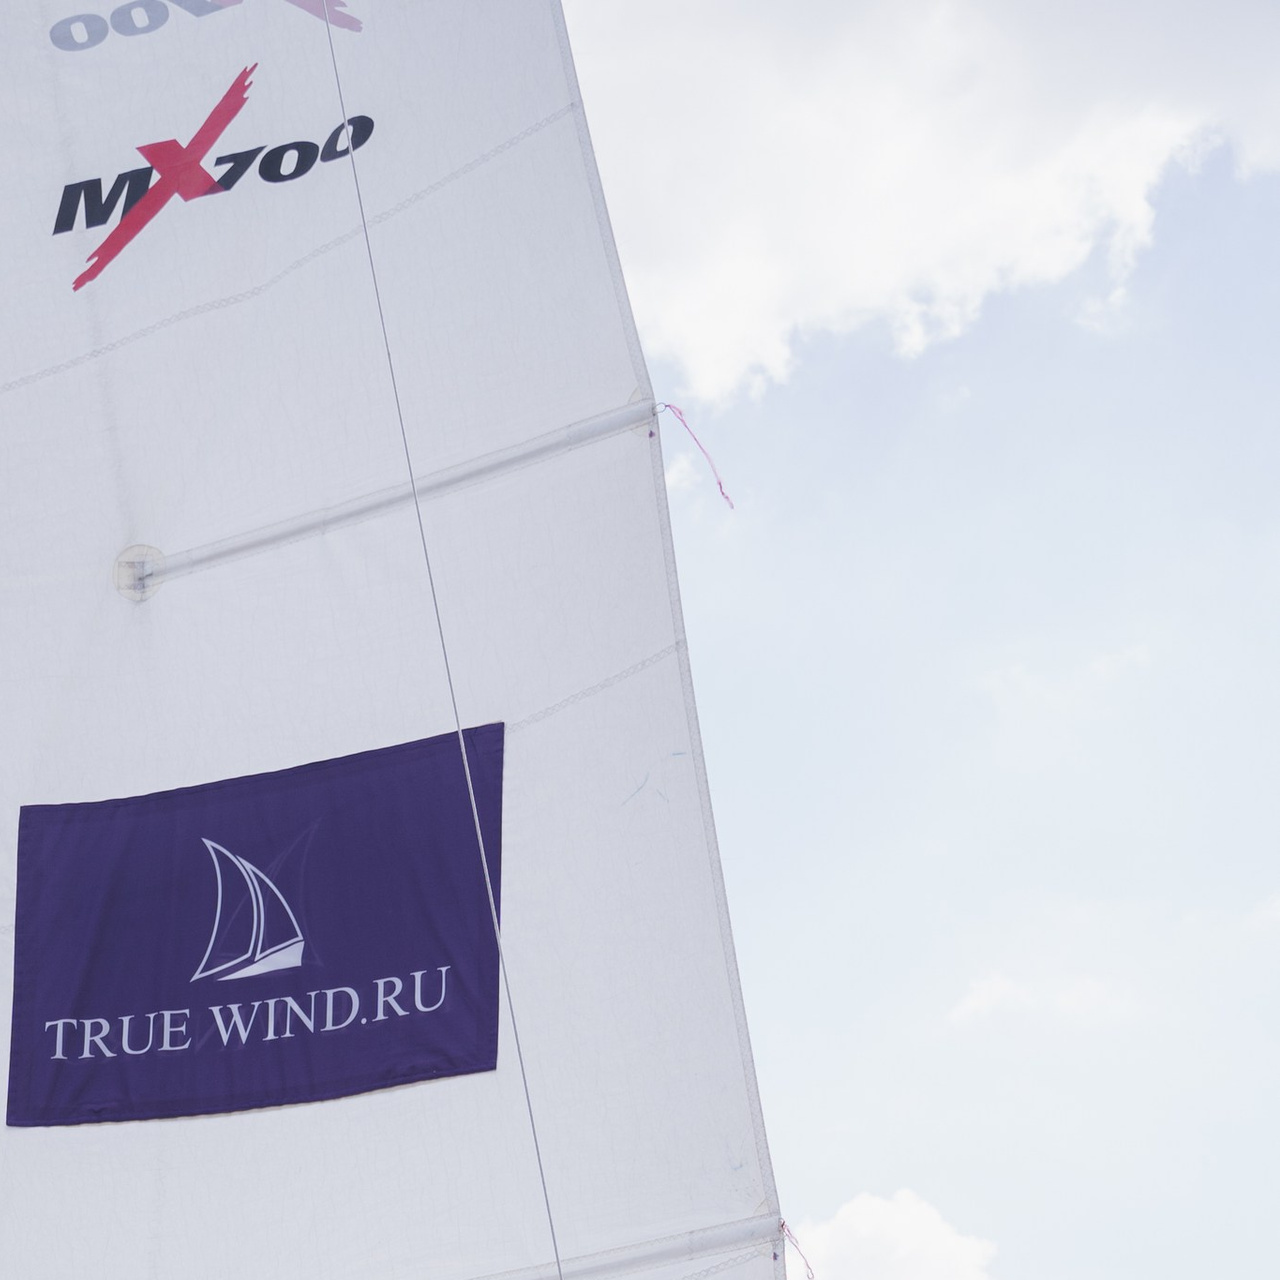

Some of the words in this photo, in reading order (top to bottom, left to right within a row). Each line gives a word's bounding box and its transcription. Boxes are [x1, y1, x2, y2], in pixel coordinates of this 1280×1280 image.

[52, 62, 375, 291] MX700
[44, 1008, 193, 1060] TRUE
[208, 965, 452, 1047] WIND.RU
